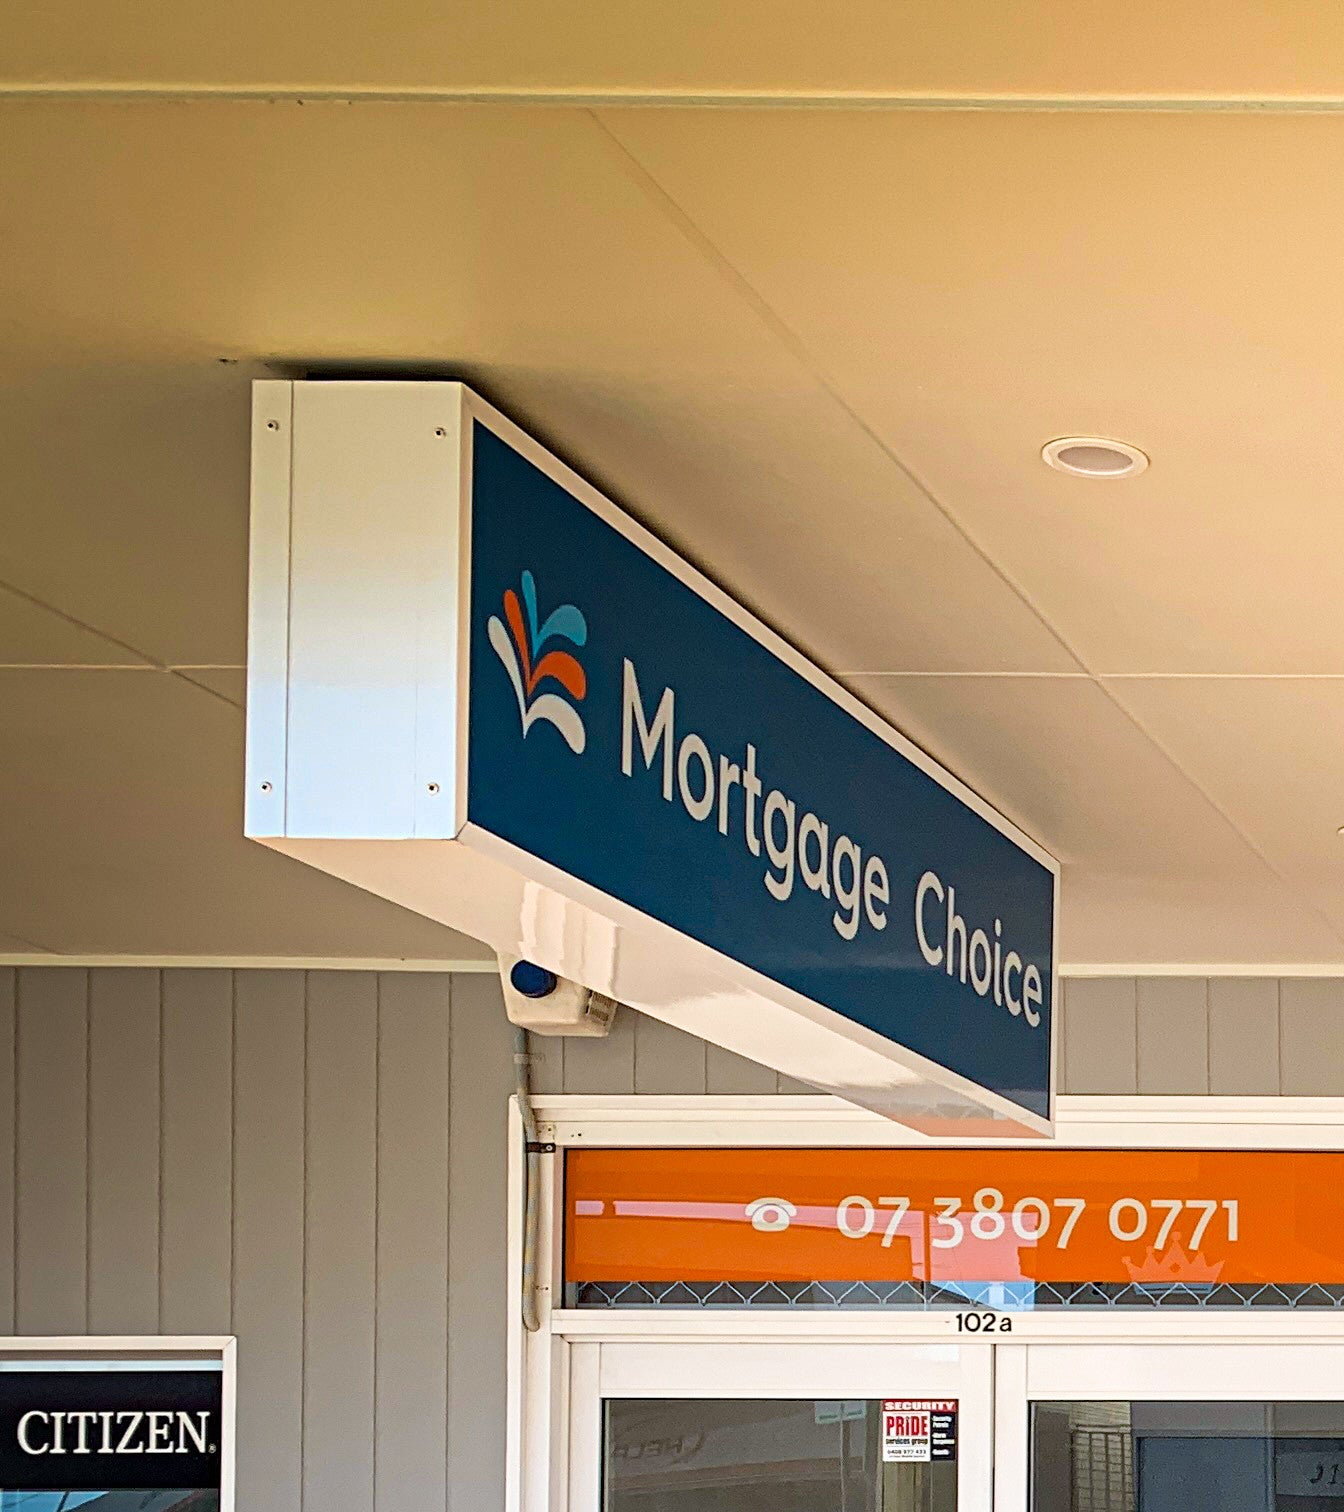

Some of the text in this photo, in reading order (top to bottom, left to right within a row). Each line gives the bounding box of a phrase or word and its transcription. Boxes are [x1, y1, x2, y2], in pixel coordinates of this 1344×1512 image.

[621, 658, 1042, 1027] Mortgage Choice
[837, 1188, 1238, 1251] 07 3807 0771
[956, 1313, 1011, 1332] 102a
[885, 1402, 955, 1410] SECURITY
[18, 1411, 210, 1454] CITIZEN
[887, 1416, 928, 1436] PRIDE
